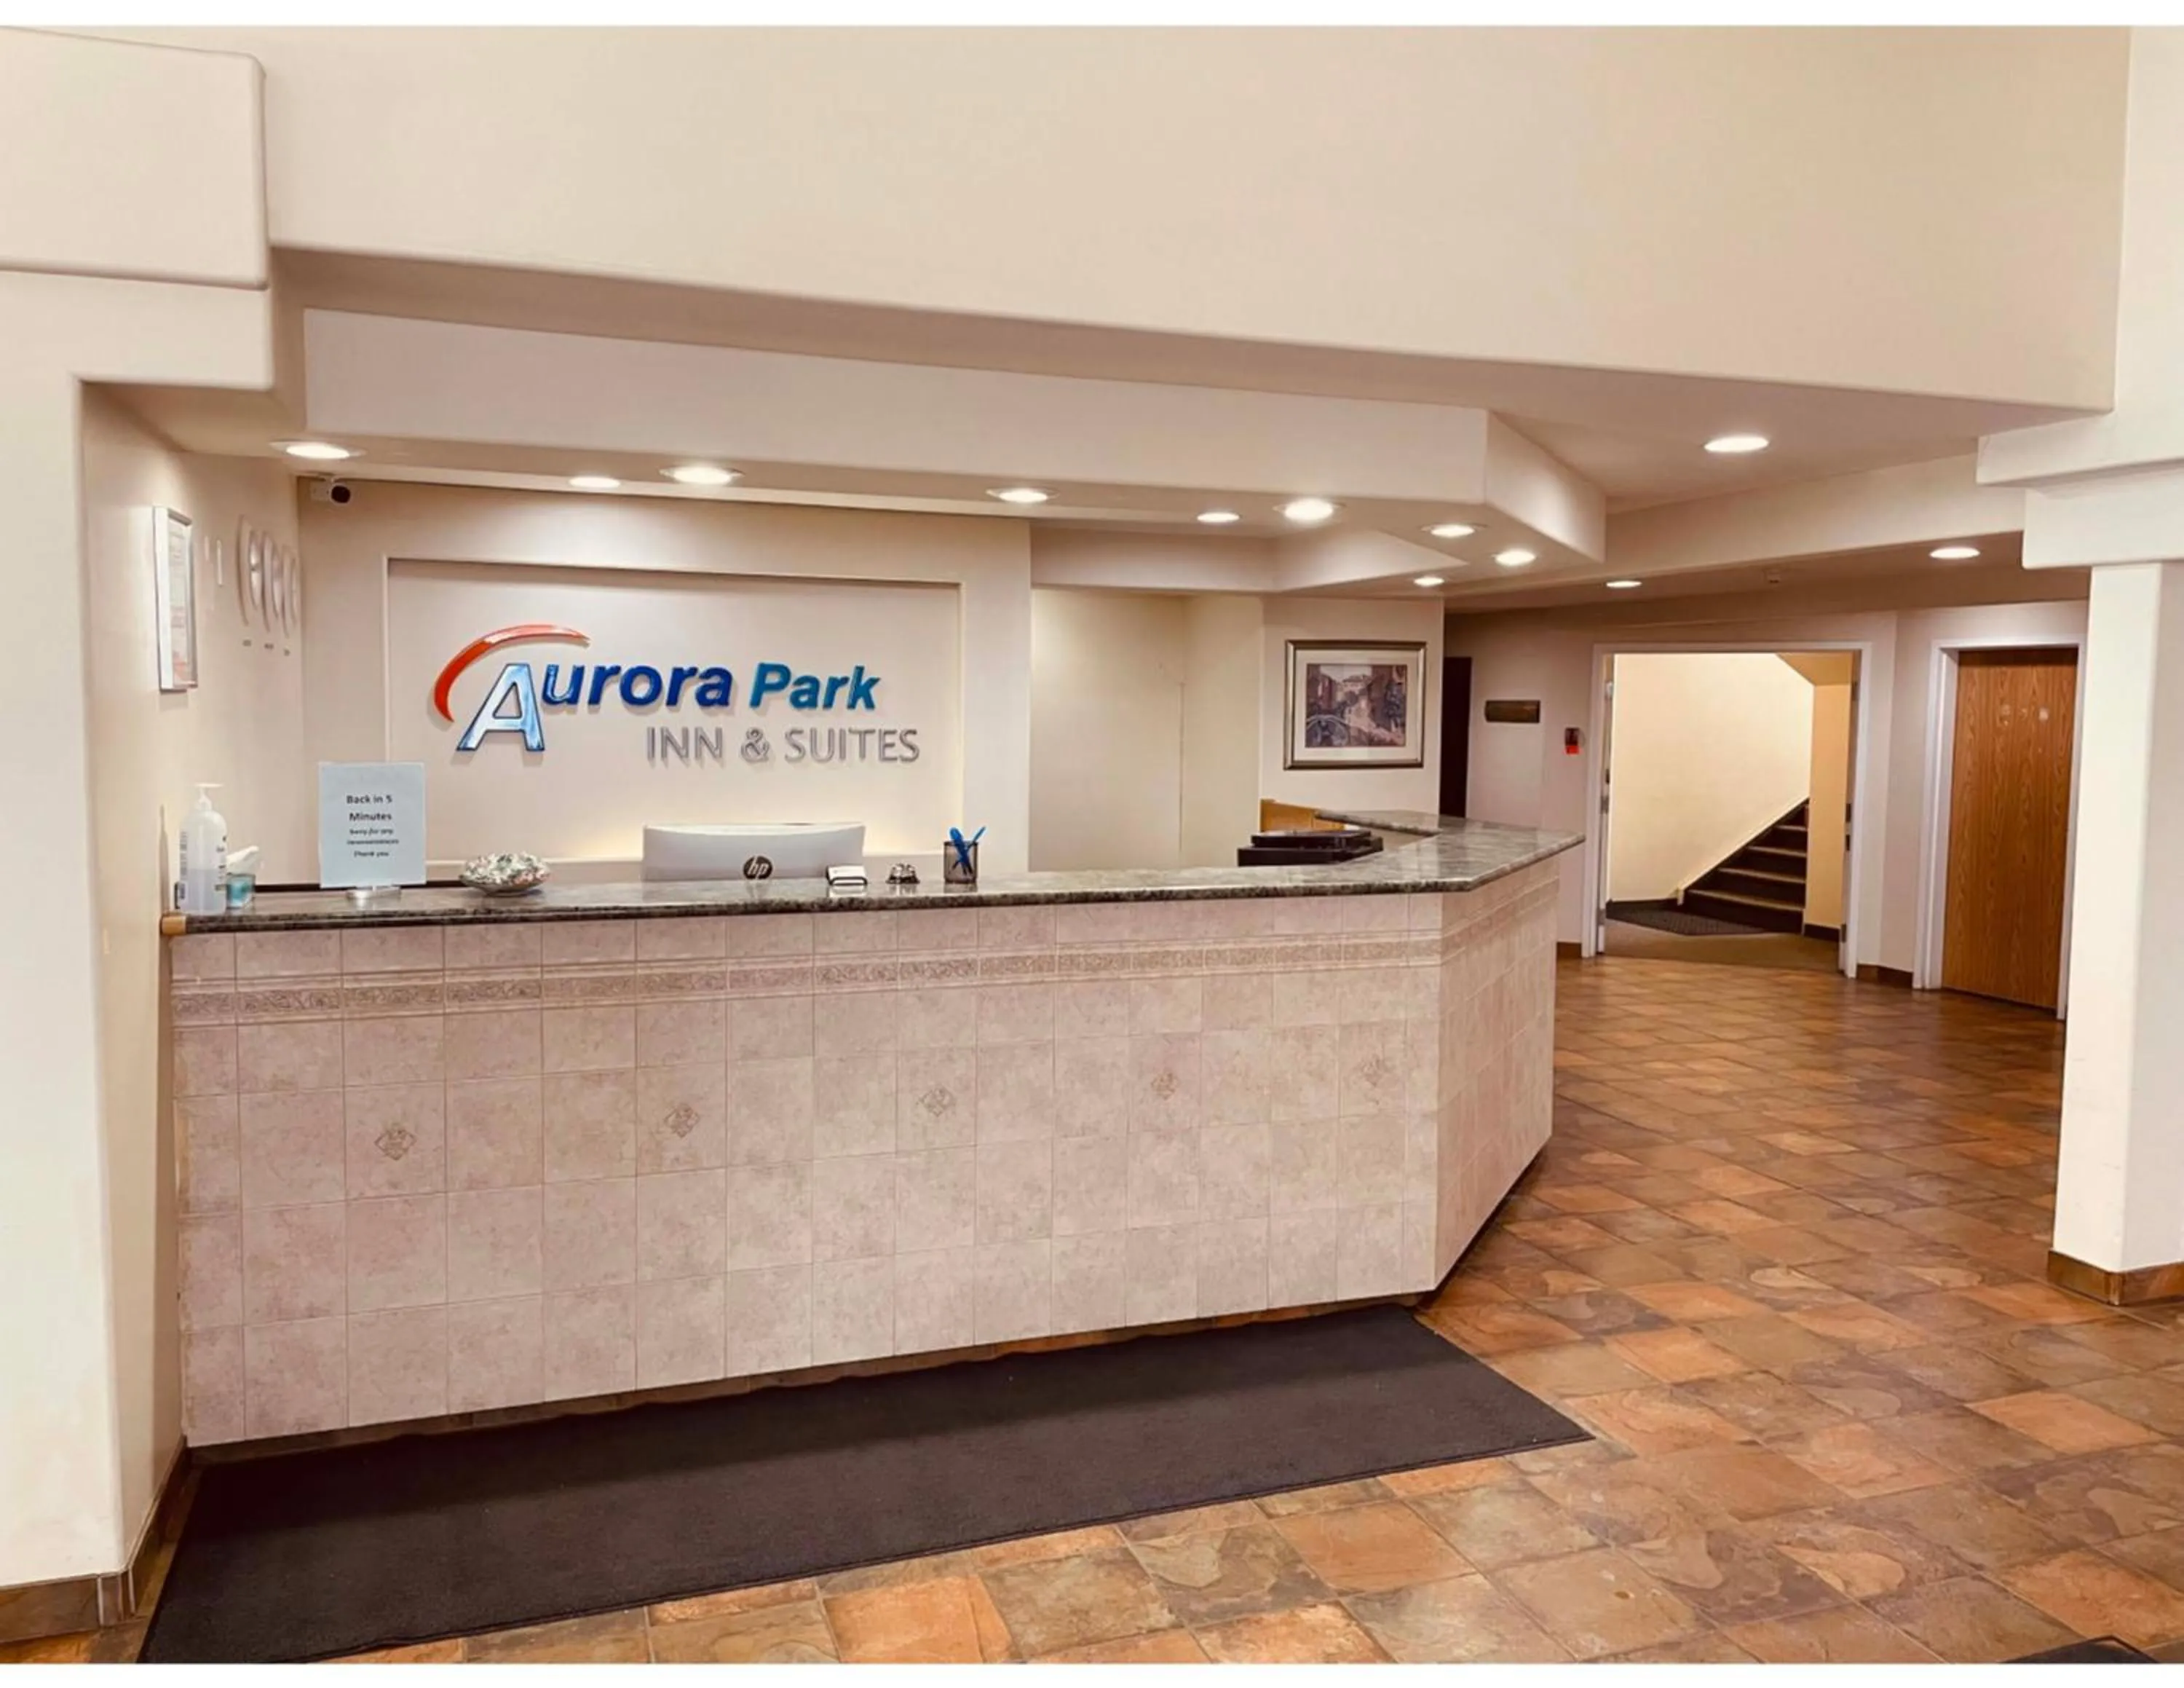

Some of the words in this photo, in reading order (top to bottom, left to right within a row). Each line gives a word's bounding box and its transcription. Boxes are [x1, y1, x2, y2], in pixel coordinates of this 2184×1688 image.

[456, 662, 732, 752] Aurora
[750, 662, 881, 710] Park
[647, 727, 724, 762] INN
[740, 728, 769, 762] &
[784, 728, 919, 762] SUITES
[347, 795, 370, 804] Back
[373, 795, 383, 803] in
[349, 812, 392, 821] Minutes
[747, 856, 769, 879] hp
